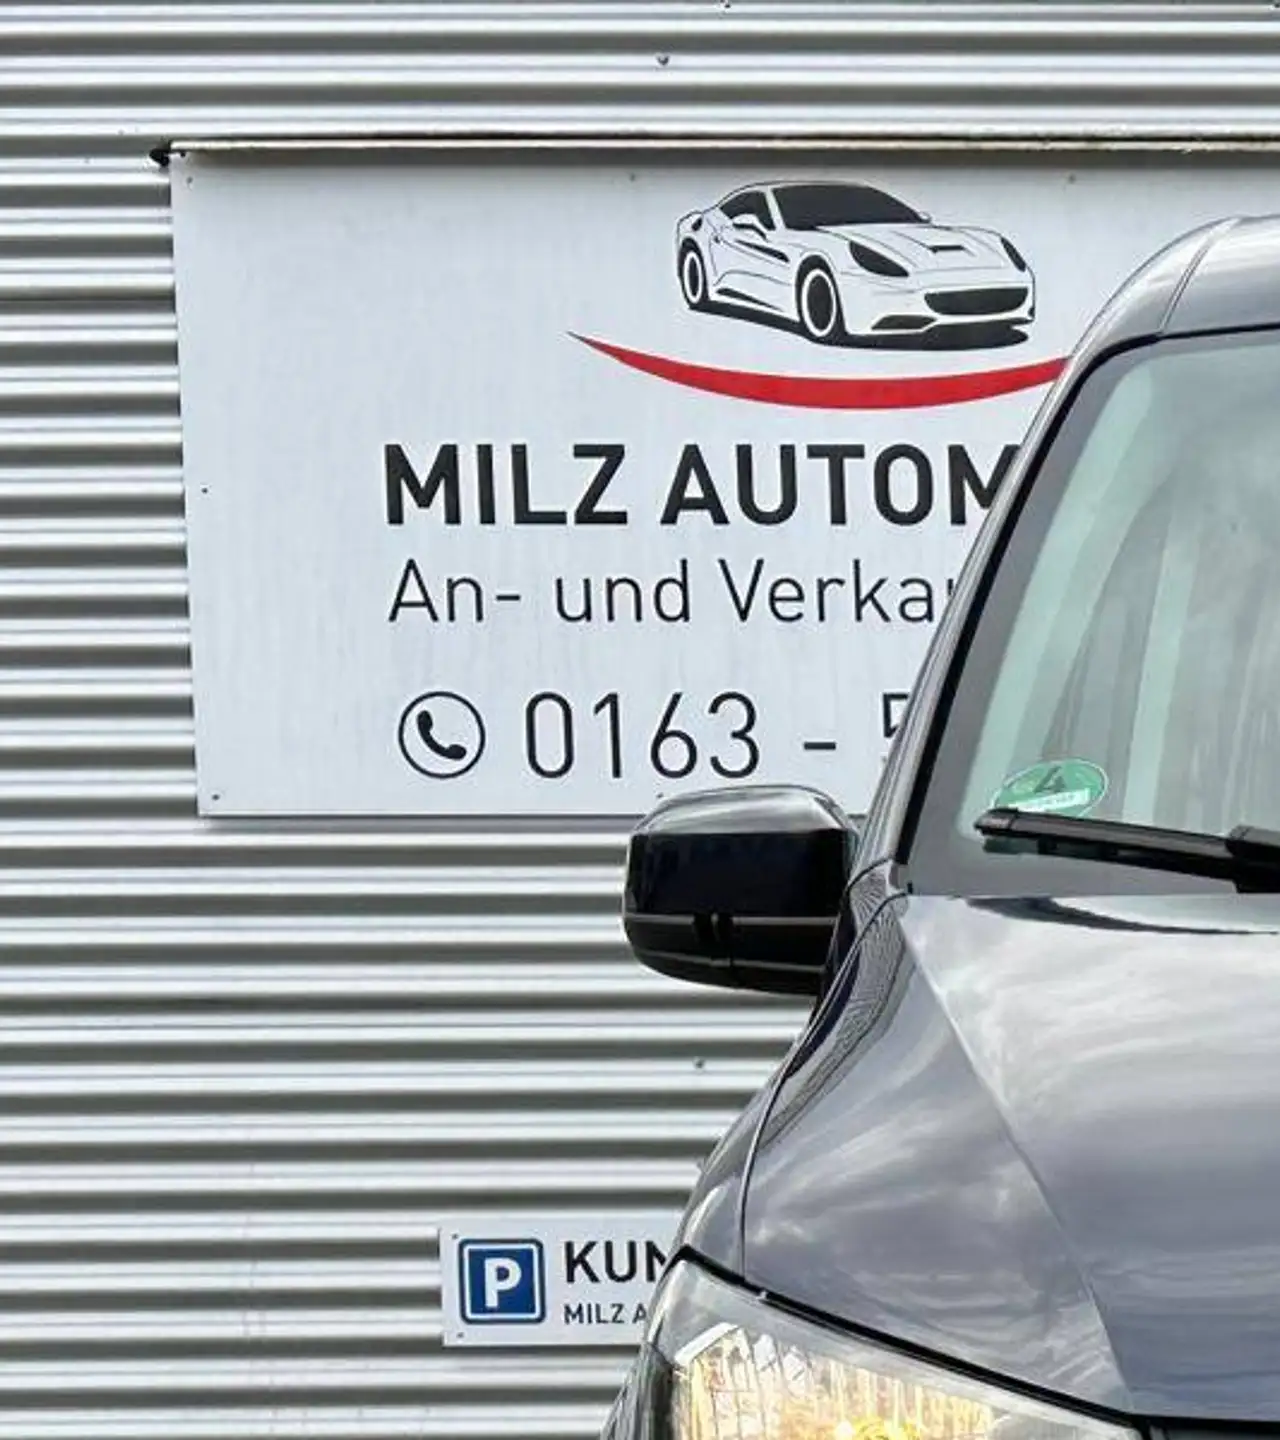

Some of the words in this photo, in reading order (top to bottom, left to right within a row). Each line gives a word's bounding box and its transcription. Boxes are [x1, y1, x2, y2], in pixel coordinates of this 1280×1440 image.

[384, 443, 628, 526] MILZ
[388, 558, 521, 623] An-
[554, 558, 691, 623] und
[717, 558, 954, 624] Verka
[525, 690, 760, 779] 0163
[563, 1303, 625, 1325] MILZ
